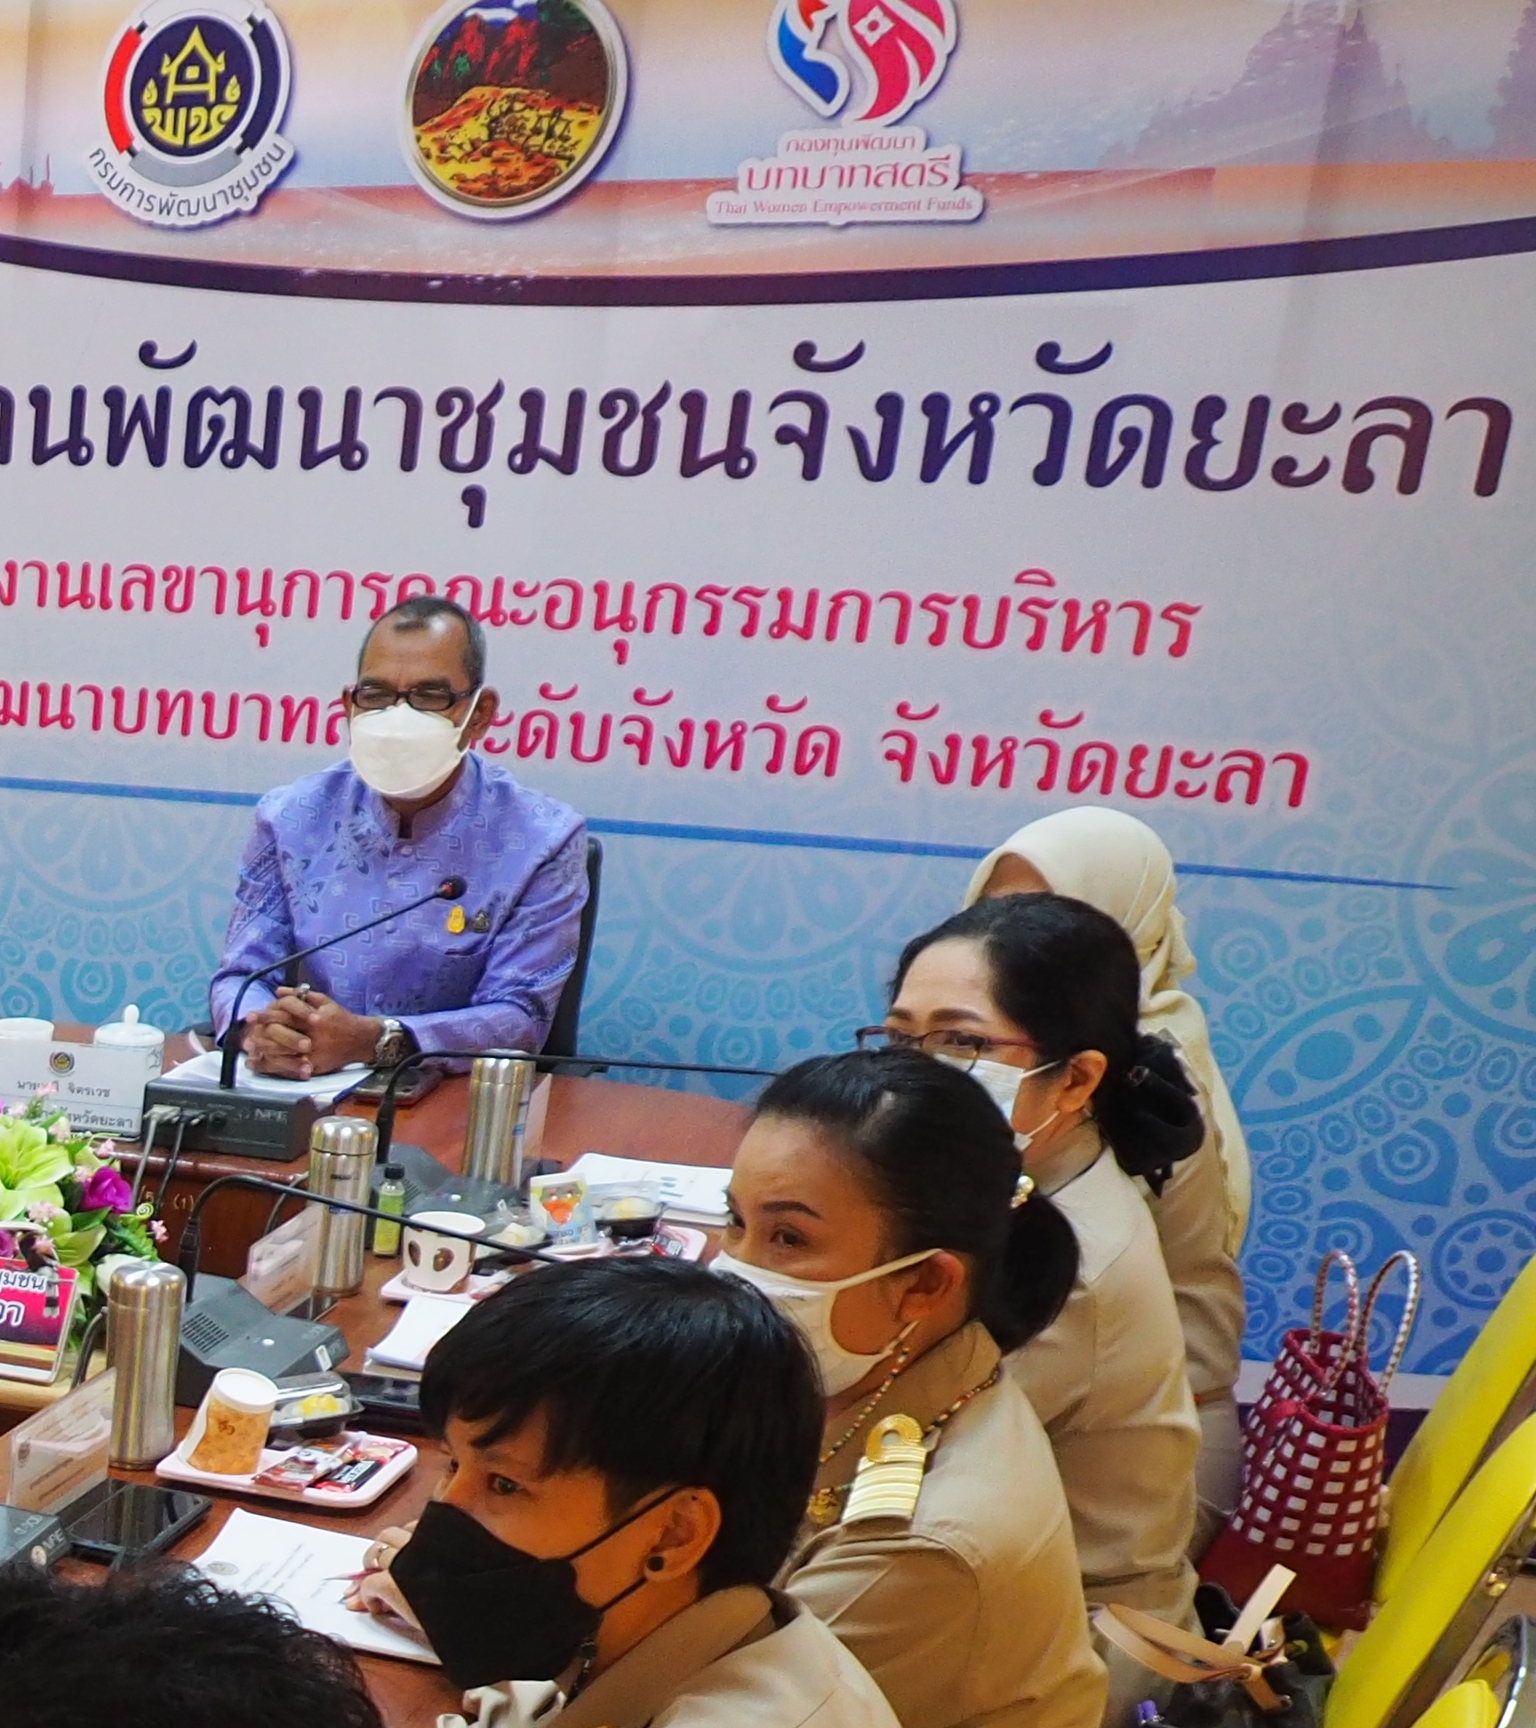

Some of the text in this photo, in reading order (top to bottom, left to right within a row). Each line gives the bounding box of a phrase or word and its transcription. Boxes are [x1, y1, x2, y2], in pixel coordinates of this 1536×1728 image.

[785, 134, 916, 157] กองทุนพัฒนา
[89, 143, 286, 217] กรมการพัฒนาชุมชน
[746, 154, 951, 191] บทบาทสตรี
[715, 198, 973, 215] Thai Women Empowerment Funds
[882, 702, 1311, 809] จังหวัดยะลา
